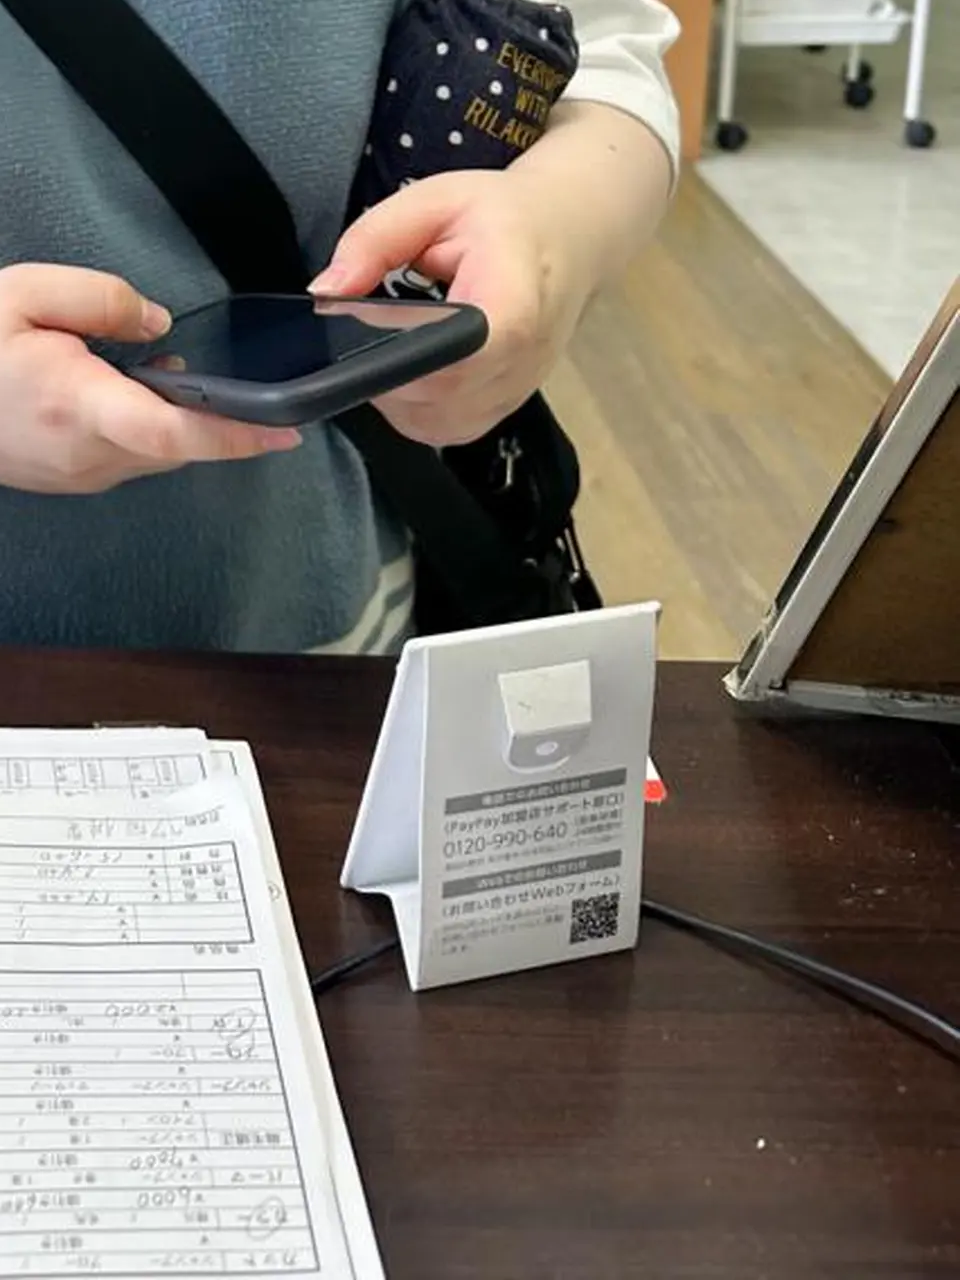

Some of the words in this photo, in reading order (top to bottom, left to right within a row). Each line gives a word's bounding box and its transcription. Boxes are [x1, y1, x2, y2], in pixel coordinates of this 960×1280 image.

[443, 821, 568, 858] 0120-990-640
[211, 1079, 271, 1092] シャンプー
[230, 1168, 284, 1185] パーマ
[136, 1186, 191, 1210] 6000
[243, 1250, 301, 1268] カット
